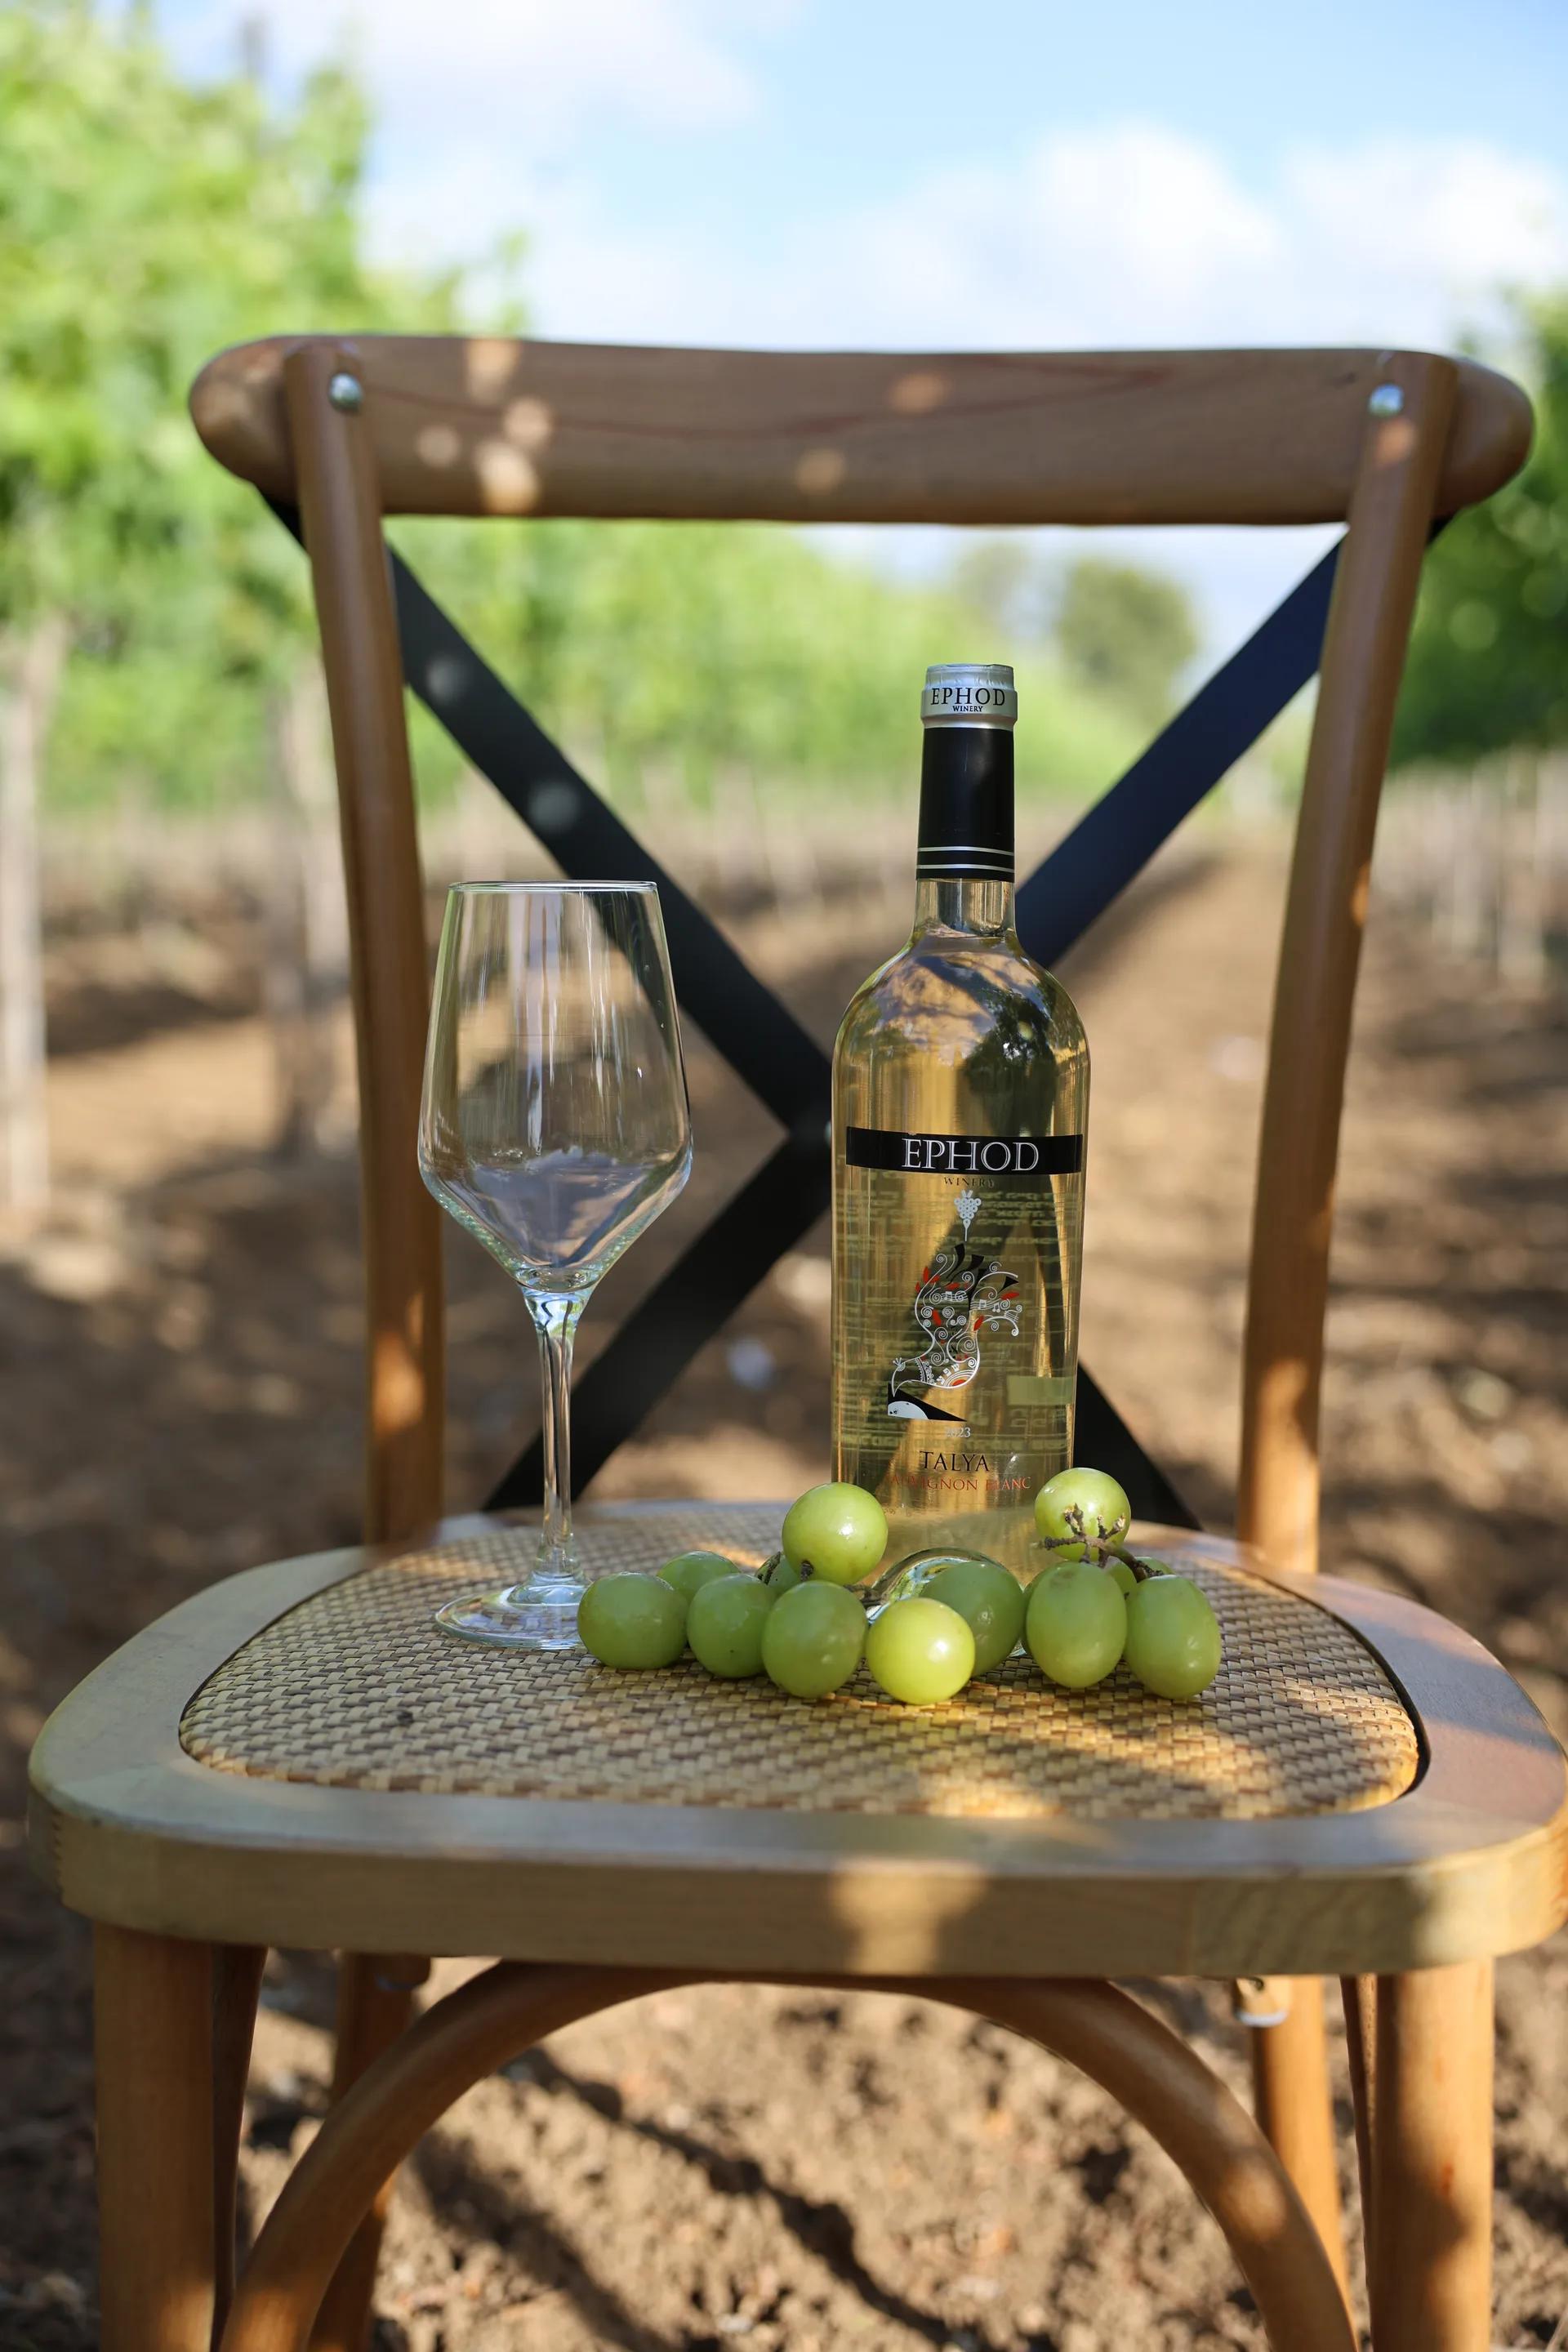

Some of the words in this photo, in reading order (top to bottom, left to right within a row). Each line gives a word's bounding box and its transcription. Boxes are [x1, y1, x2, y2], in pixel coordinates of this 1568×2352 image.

[930, 687, 1005, 706] EPHOD
[902, 1138, 1040, 1171] EPHOD
[945, 1427, 971, 1437] 23
[920, 1450, 989, 1472] TALYA
[887, 1472, 978, 1490] AUVIGNON
